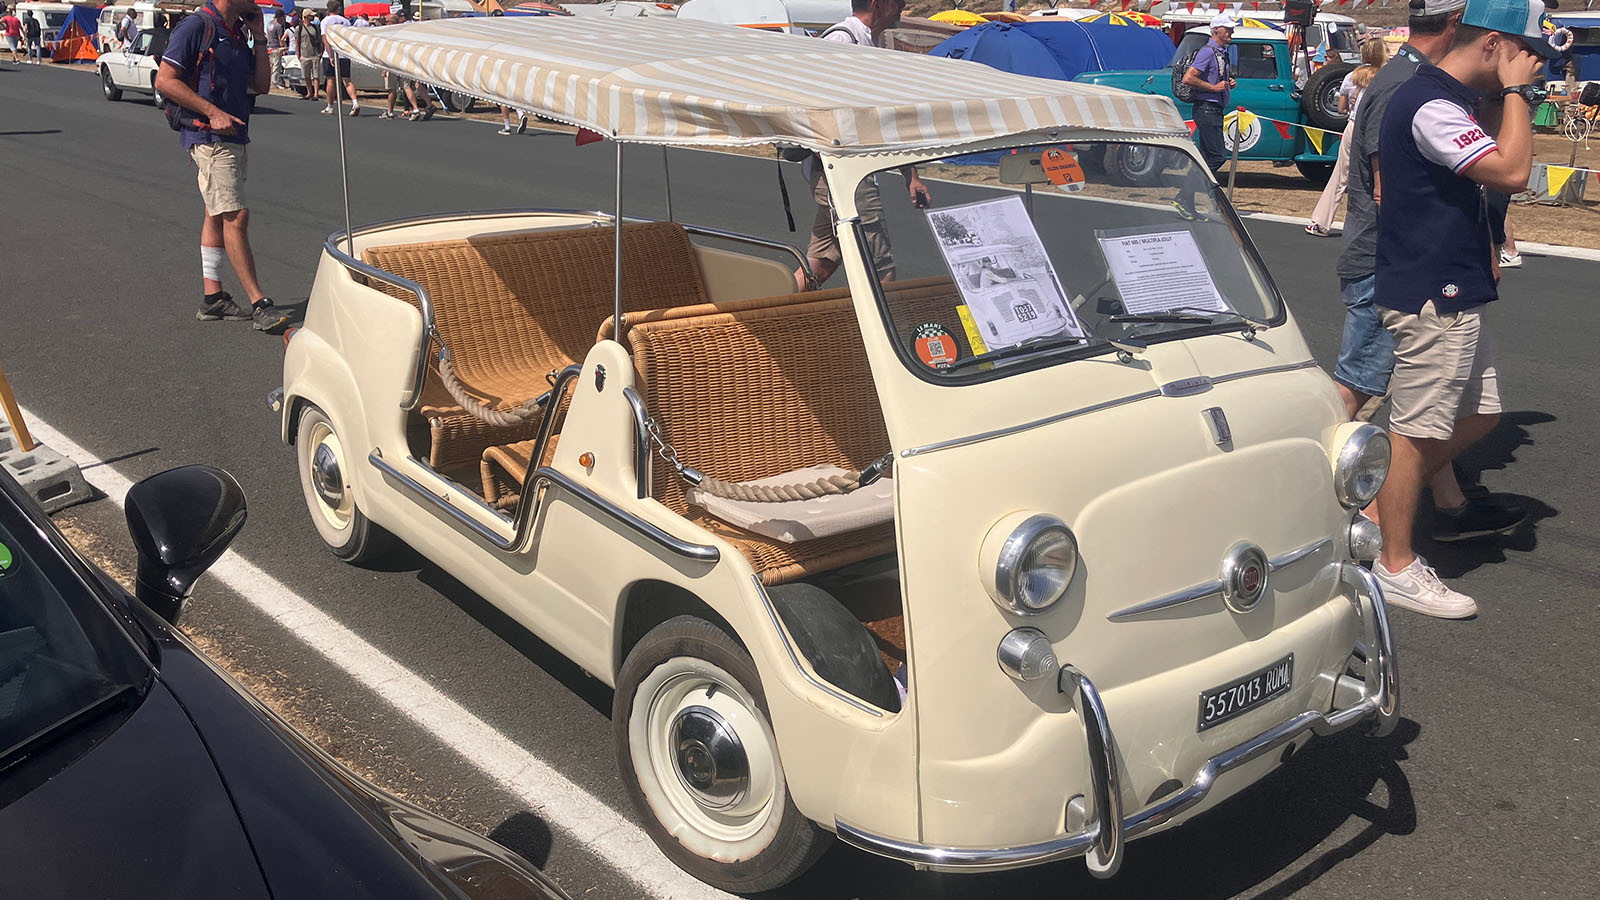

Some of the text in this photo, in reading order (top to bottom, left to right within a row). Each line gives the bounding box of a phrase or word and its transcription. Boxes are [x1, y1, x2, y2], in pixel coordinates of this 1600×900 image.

[1452, 128, 1486, 149] 1923
[923, 322, 942, 330] MANS
[1205, 661, 1289, 720] 557013 ROMA
